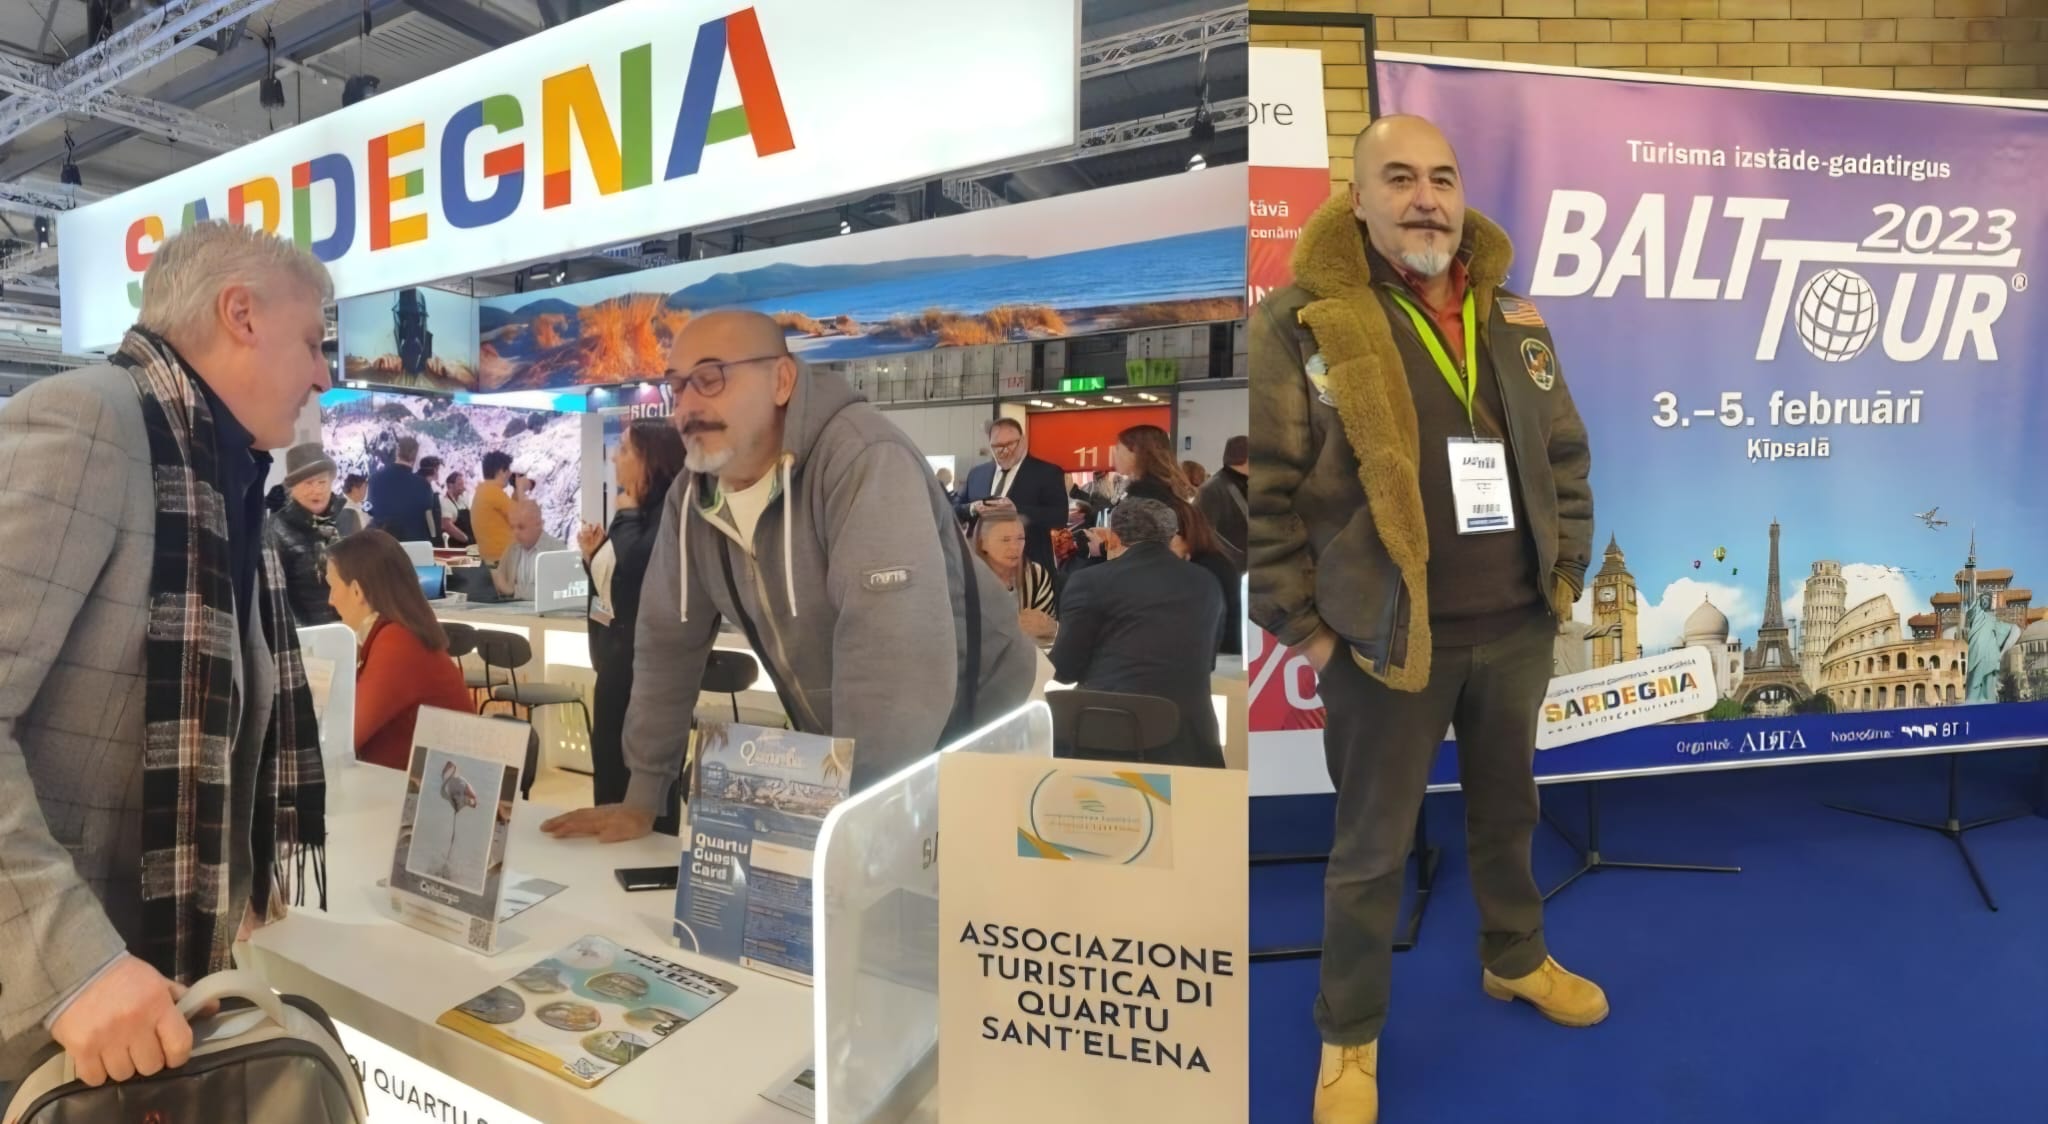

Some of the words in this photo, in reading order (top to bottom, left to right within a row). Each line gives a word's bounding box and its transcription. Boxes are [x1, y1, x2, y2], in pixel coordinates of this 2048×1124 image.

[125, 6, 796, 309] SDEGNA
[1627, 140, 1726, 166] Tūrisma
[1735, 146, 1951, 181] izstāde-gadatirgus
[1529, 189, 1790, 300] BALT
[1862, 203, 2018, 253] 2023
[1769, 390, 1925, 426] februārī
[1073, 446, 1099, 467] 11
[1747, 437, 1831, 463] Ķīpsalā
[1544, 672, 1698, 722] SARDEGNA
[692, 862, 727, 880] Card
[959, 920, 1234, 977] ASSOCIAZIONE
[978, 953, 1161, 1000] TURISTICA
[1176, 978, 1212, 1008] DI
[1017, 991, 1169, 1032] QUARTU
[982, 1016, 1211, 1073] SANT'ELENA
[374, 1068, 468, 1124] QUARTU
